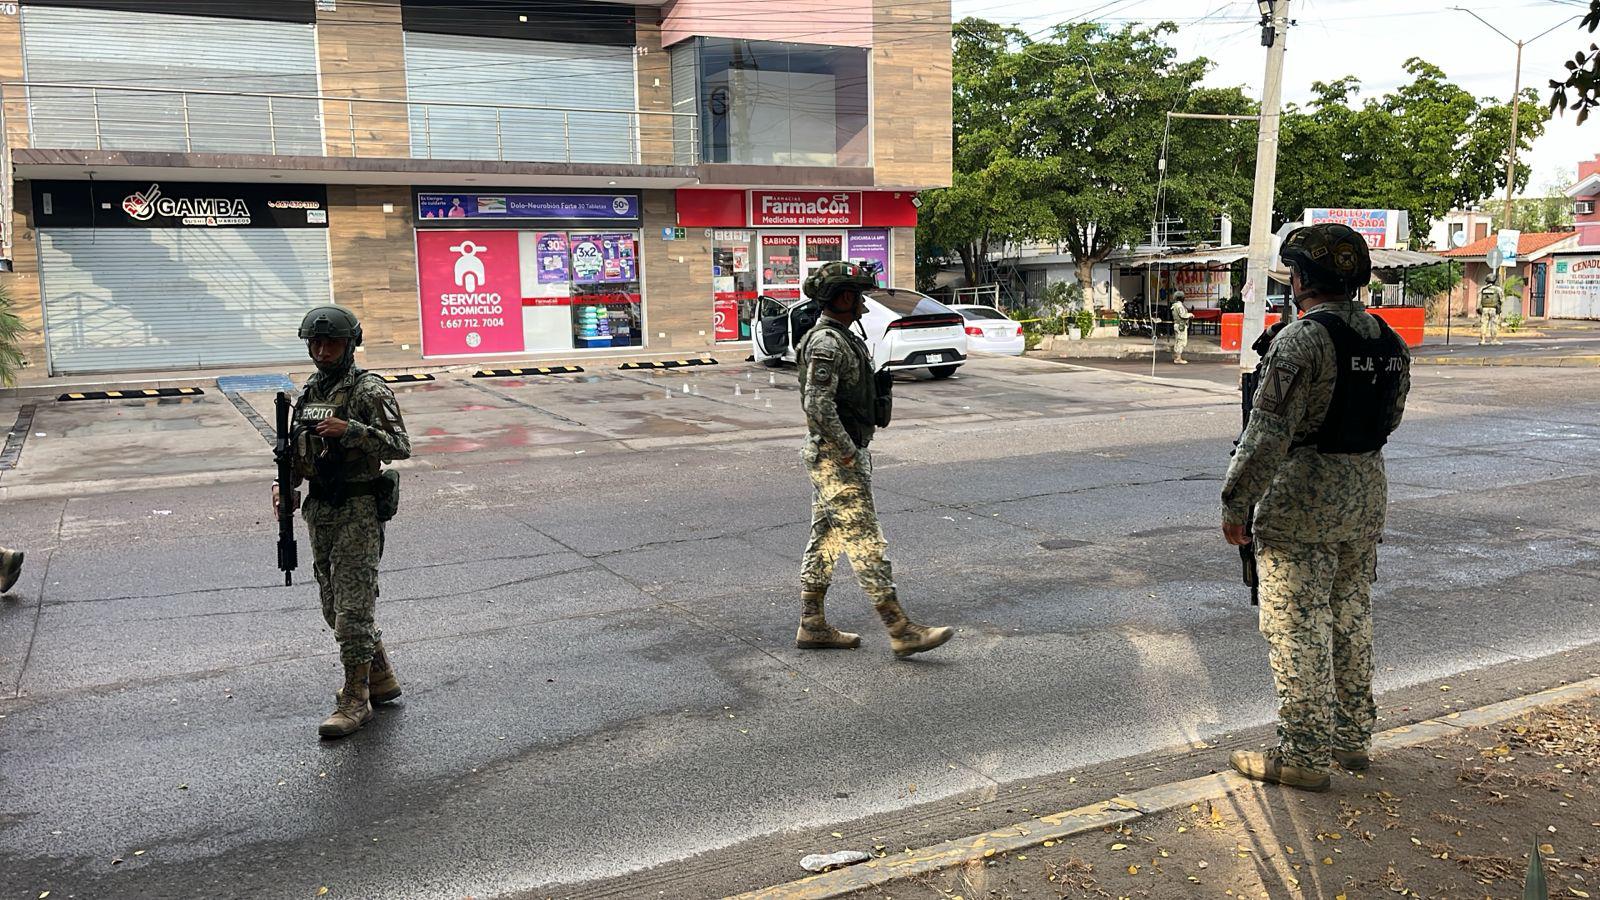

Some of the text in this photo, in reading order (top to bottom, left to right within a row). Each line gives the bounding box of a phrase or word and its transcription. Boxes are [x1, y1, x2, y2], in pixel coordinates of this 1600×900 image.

[637, 46, 648, 56] 11
[157, 197, 250, 217] GAMBA
[561, 202, 577, 210] Forte
[1329, 209, 1363, 217] POLLO
[806, 216, 826, 225] mejor
[827, 216, 849, 225] precio
[1351, 219, 1386, 227] ASADA
[704, 229, 711, 238] 6
[763, 237, 797, 245] SABINOS
[807, 236, 840, 244] SABINOS
[578, 247, 597, 257] 3x2
[440, 293, 501, 305] SERVICIO
[441, 305, 503, 316] A DOMICILIO
[482, 318, 504, 327] 7004
